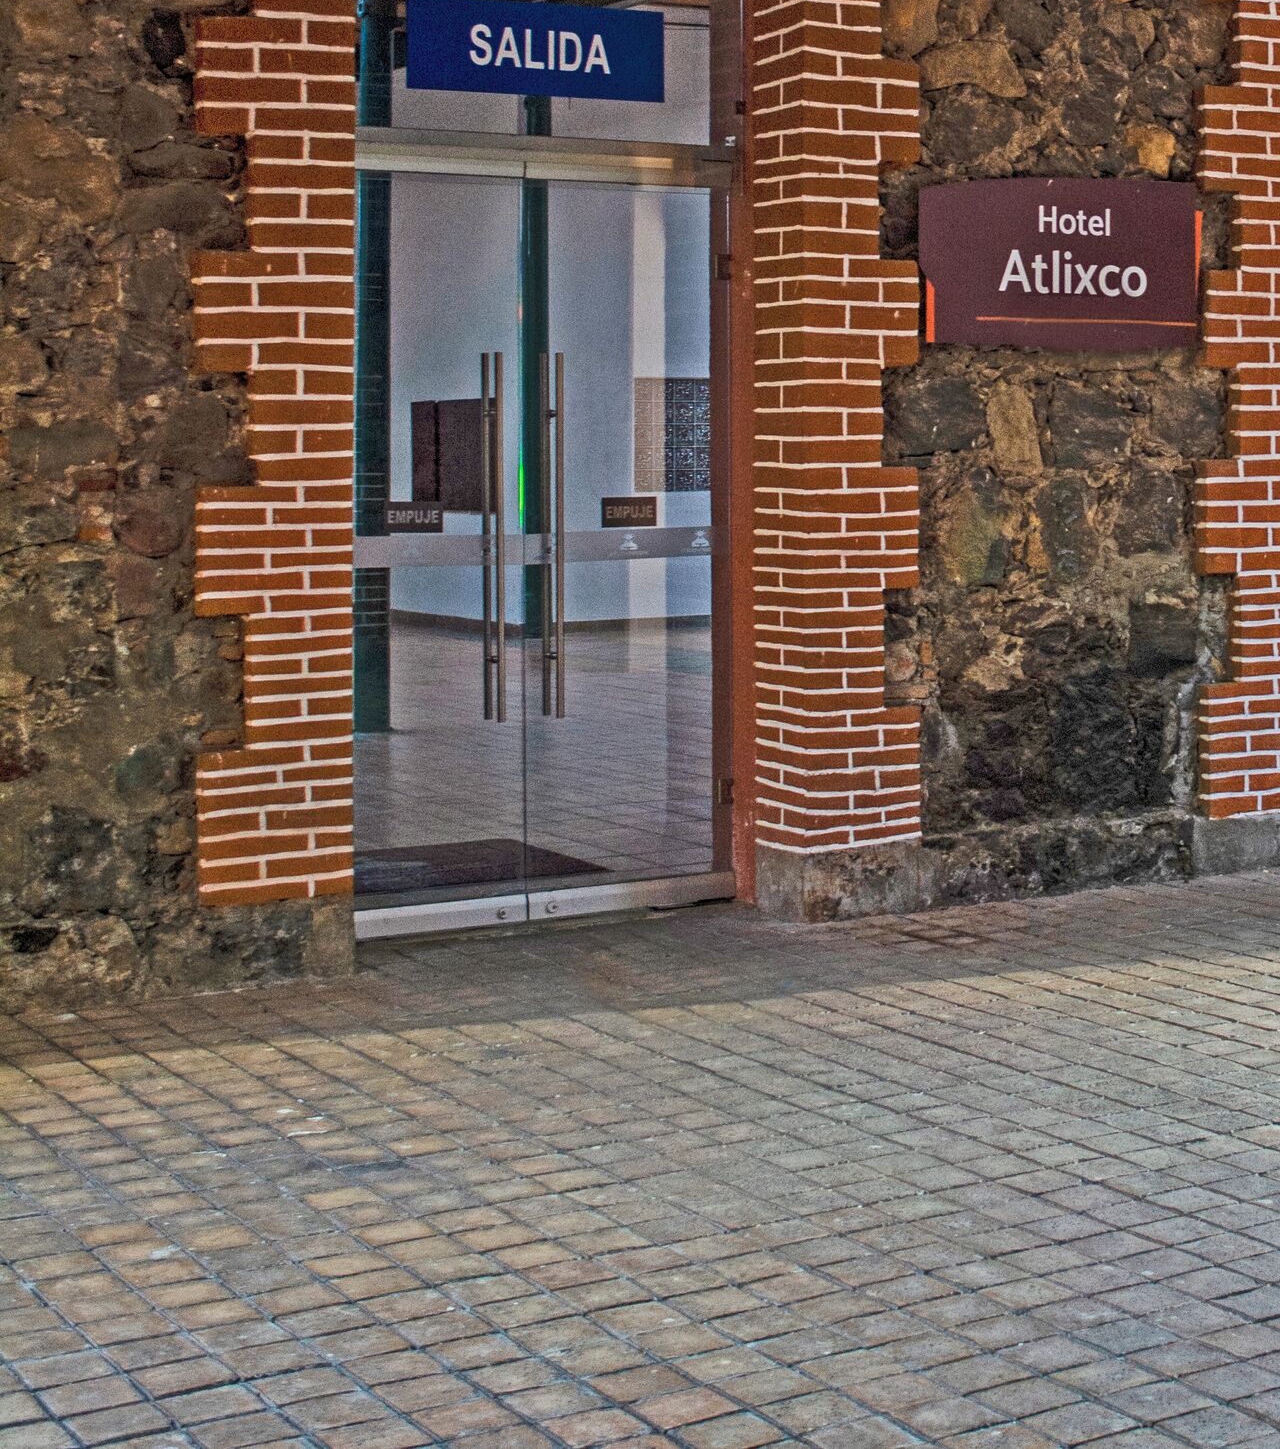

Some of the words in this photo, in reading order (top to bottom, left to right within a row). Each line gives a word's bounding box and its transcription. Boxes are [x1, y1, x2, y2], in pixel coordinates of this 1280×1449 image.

[469, 24, 611, 74] SALIDA
[1038, 205, 1111, 236] Hotel
[998, 249, 1148, 297] Atlixco
[387, 510, 439, 524] EMPUJE
[606, 505, 654, 518] EMPUJE
